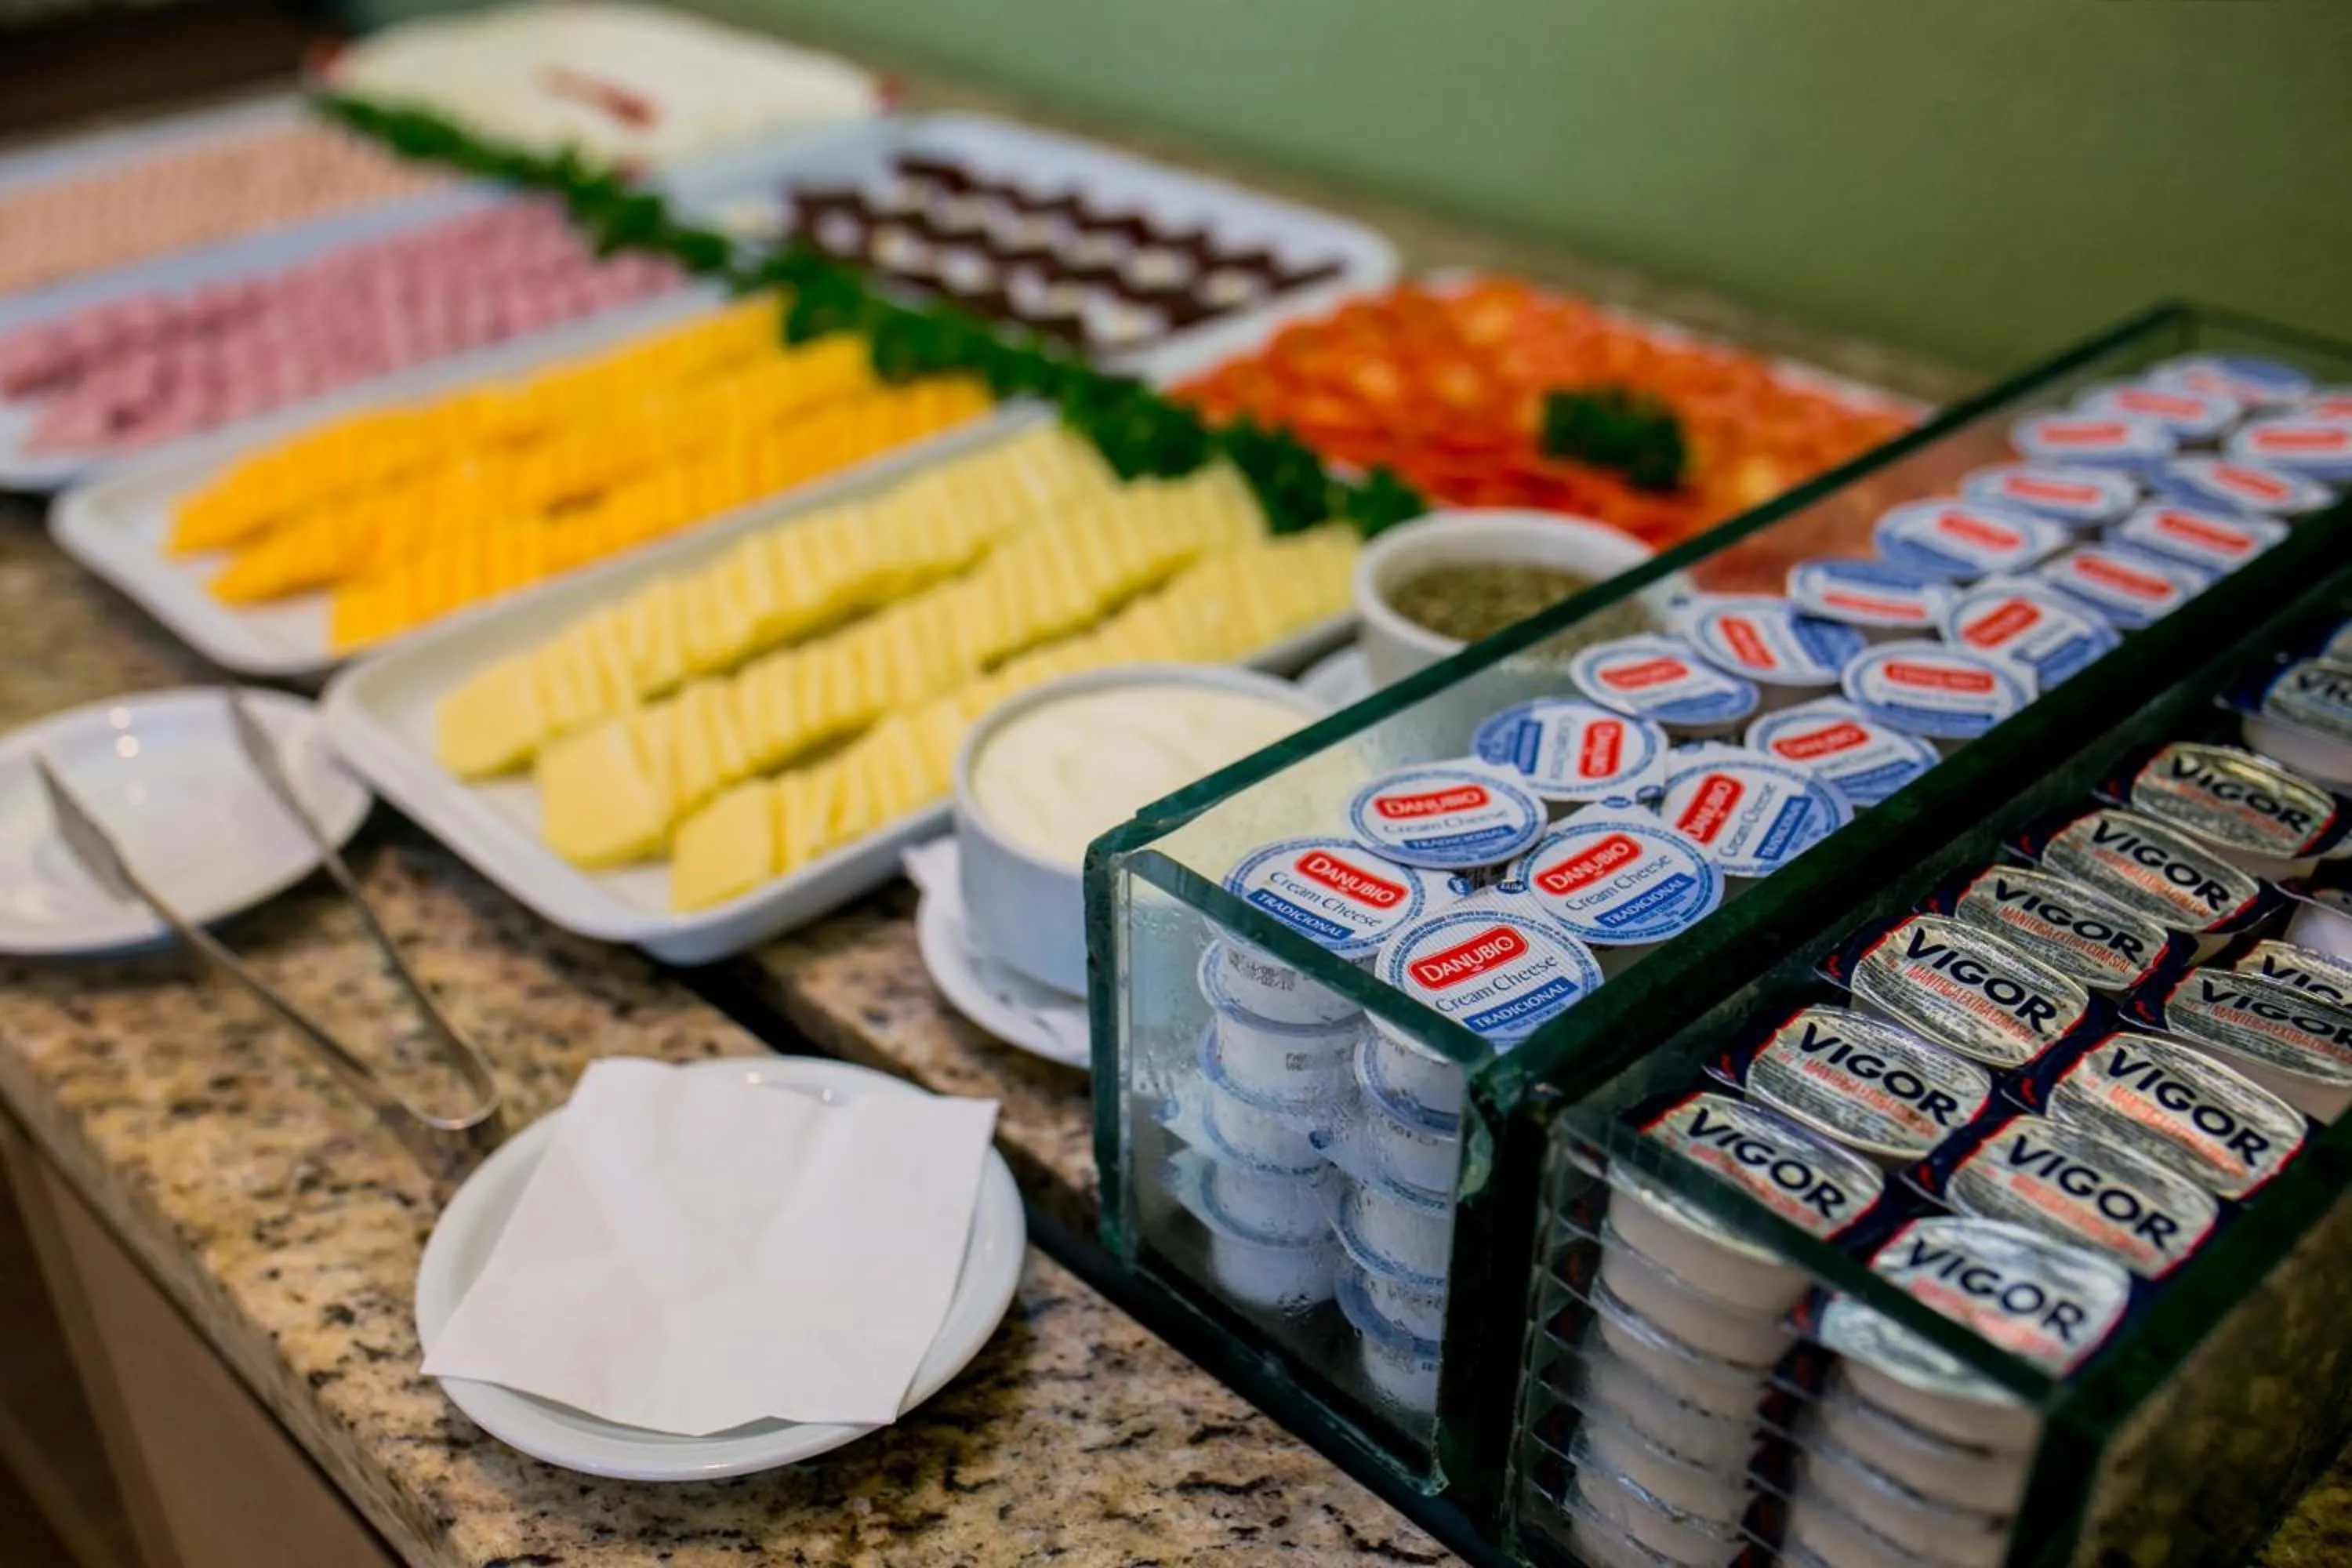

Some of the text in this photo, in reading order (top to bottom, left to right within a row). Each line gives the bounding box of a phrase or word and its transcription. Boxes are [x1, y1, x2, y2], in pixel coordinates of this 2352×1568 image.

[1385, 789, 1481, 815] DANUBIO
[2172, 754, 2311, 833] VIGOR
[1307, 857, 1396, 902] DANUBIO
[1546, 842, 1630, 889] DANUBIO
[1566, 886, 1616, 910] Cream
[1614, 855, 1673, 889] Cheese
[2092, 820, 2230, 911] VIGOR
[1258, 892, 1344, 938] TRADICIONAL
[1270, 871, 1322, 902] Cream
[1322, 898, 1381, 927] Cheese
[1608, 879, 1686, 924] TRADICIONAL
[1996, 878, 2143, 964] VIGOR
[1420, 936, 1515, 982] DANUBIO
[1436, 955, 1558, 1012] Cream Cheese
[1907, 927, 2056, 1033] VIGOR
[1475, 983, 1567, 1029] TRADICIONAL
[1801, 1022, 1958, 1126] VIGOR
[2108, 1047, 2270, 1166] VIGOR
[1688, 1108, 1846, 1218] VIGOR
[2008, 1134, 2178, 1250] VIGOR
[1907, 1240, 2085, 1339] VIGOR
